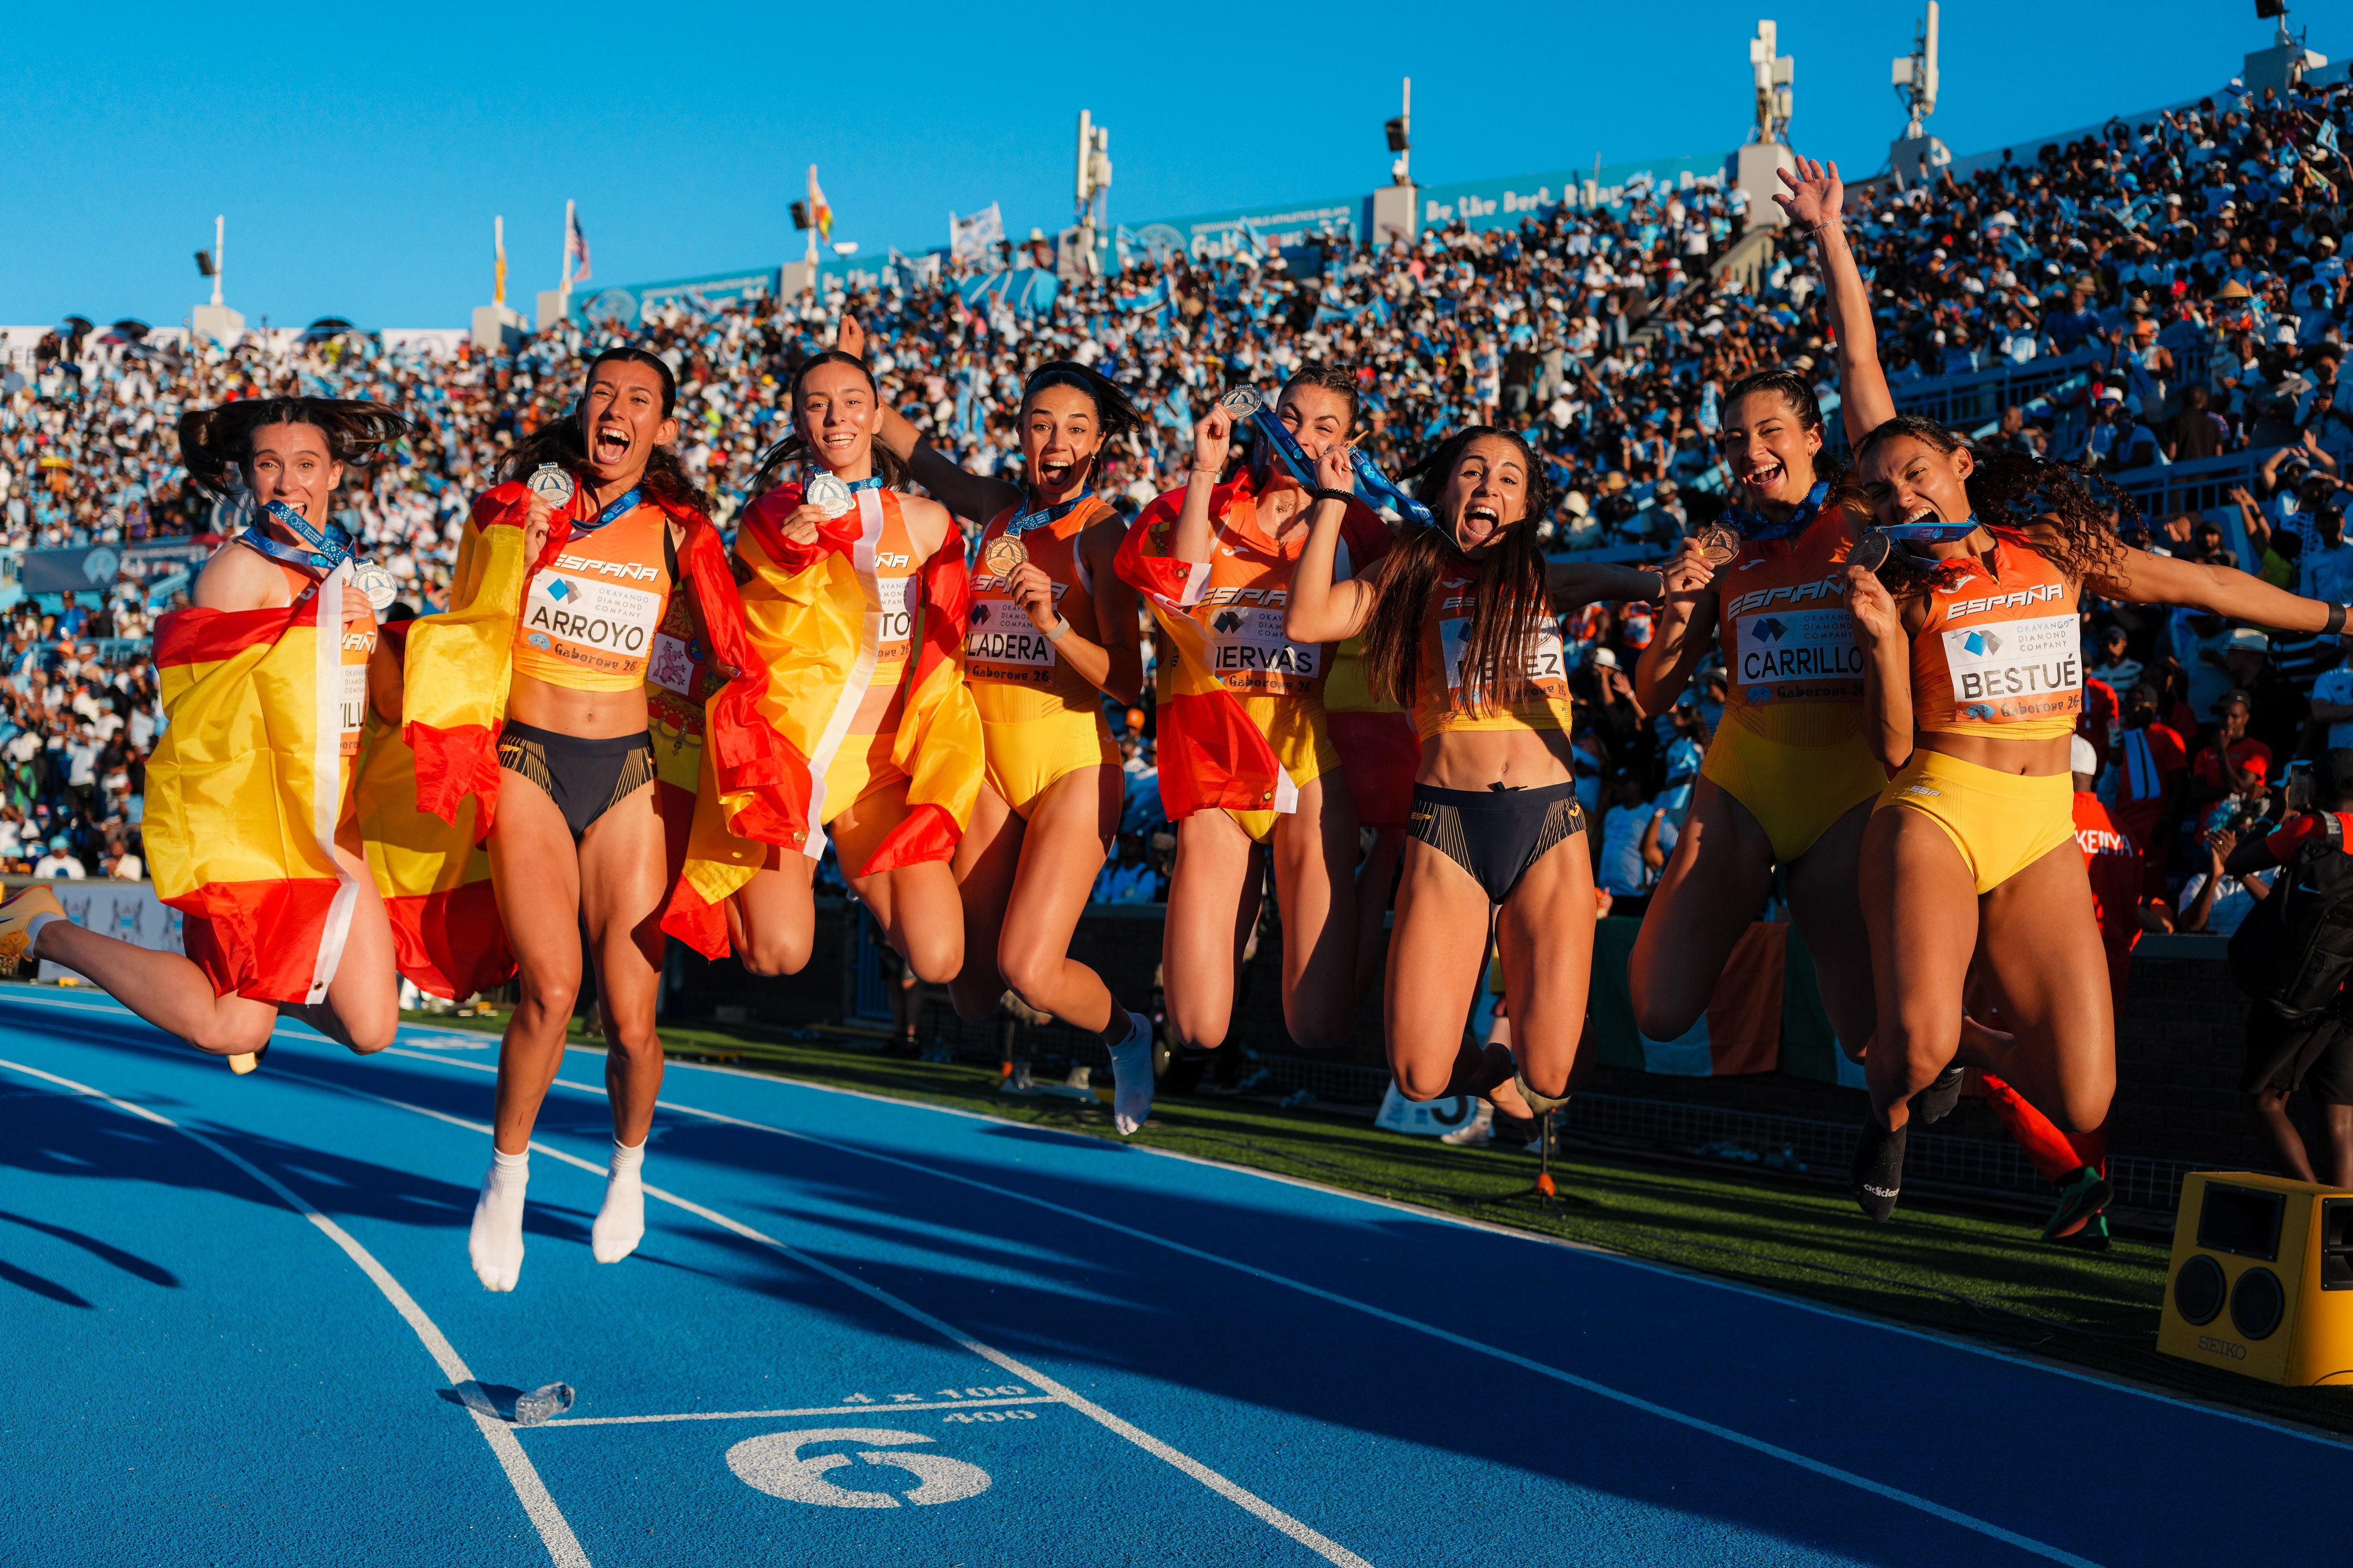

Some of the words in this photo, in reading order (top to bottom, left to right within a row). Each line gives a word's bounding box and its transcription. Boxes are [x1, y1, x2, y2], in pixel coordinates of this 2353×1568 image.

[554, 554, 660, 582] ESPAÑA
[599, 588, 649, 603] OKAVANGO
[1727, 574, 1845, 623] ESPAÑ
[1946, 584, 2064, 621] ESPAÑA
[597, 596, 642, 610] DIAMOND
[595, 604, 641, 619] COMPANY
[1804, 614, 1850, 622] OKAVANG
[530, 606, 644, 651] ARROYO
[883, 612, 910, 636] TO
[1258, 622, 1282, 630] DIAM
[1804, 623, 1853, 631] DIAMOND
[2017, 619, 2070, 633] OKAVANGO
[1258, 630, 1286, 638] COMP
[2018, 630, 2066, 643] DIAMOND
[2020, 640, 2067, 652] COMPANY
[622, 659, 638, 671] 26
[1744, 646, 1864, 680] CARRILLO
[1034, 670, 1049, 681] 26
[1960, 653, 2077, 699] BESTUÉ
[1298, 681, 1311, 692] 26
[1909, 785, 1941, 797] ESP
[2074, 829, 2133, 858] KENYA
[1863, 1184, 1900, 1198] adidas
[2197, 1334, 2247, 1361] SEIKO
[936, 1385, 1028, 1399] 100
[942, 1409, 1038, 1424] 400
[725, 1427, 993, 1508] 6
